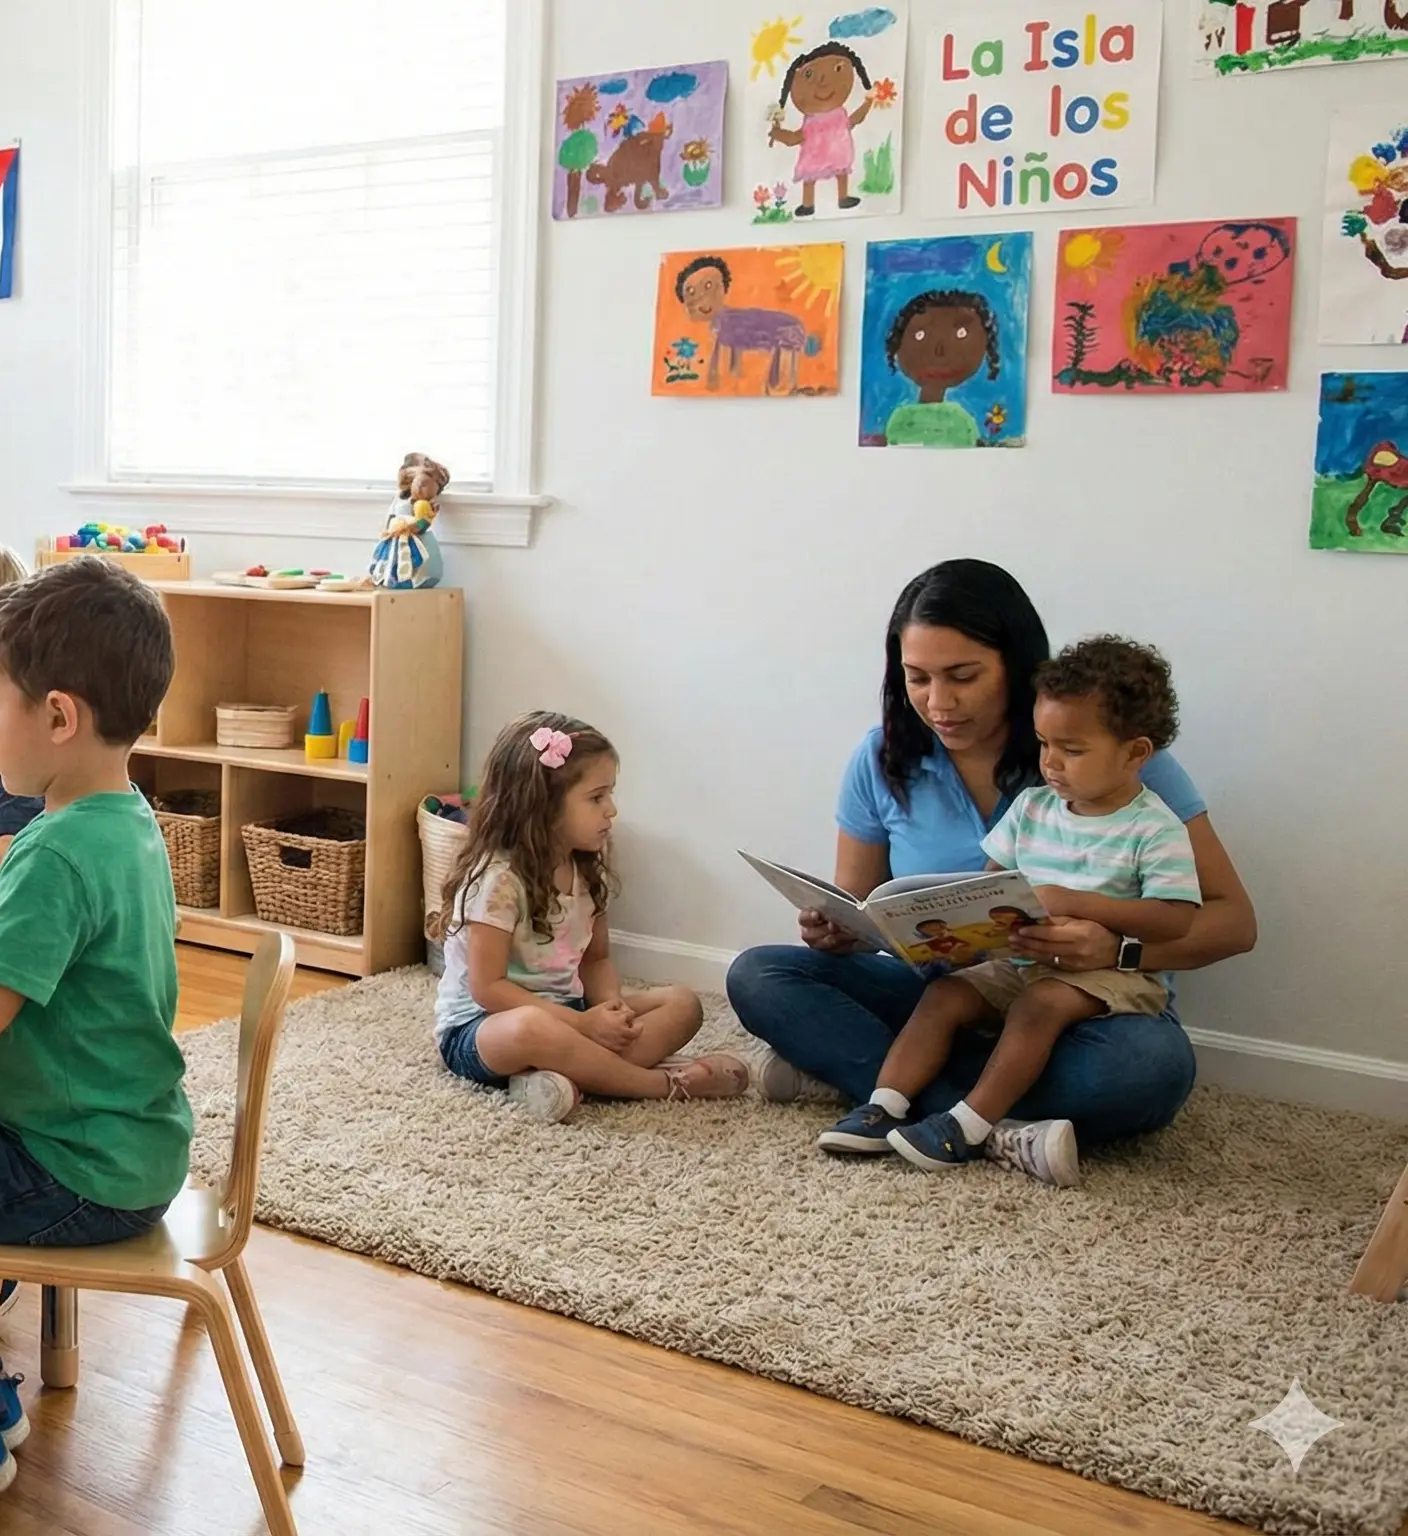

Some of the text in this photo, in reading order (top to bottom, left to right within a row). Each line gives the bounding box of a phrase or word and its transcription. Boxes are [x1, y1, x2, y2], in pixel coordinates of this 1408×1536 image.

[943, 13, 1134, 81] La Isla
[945, 85, 1129, 145] de los
[958, 151, 1118, 209] Niños
